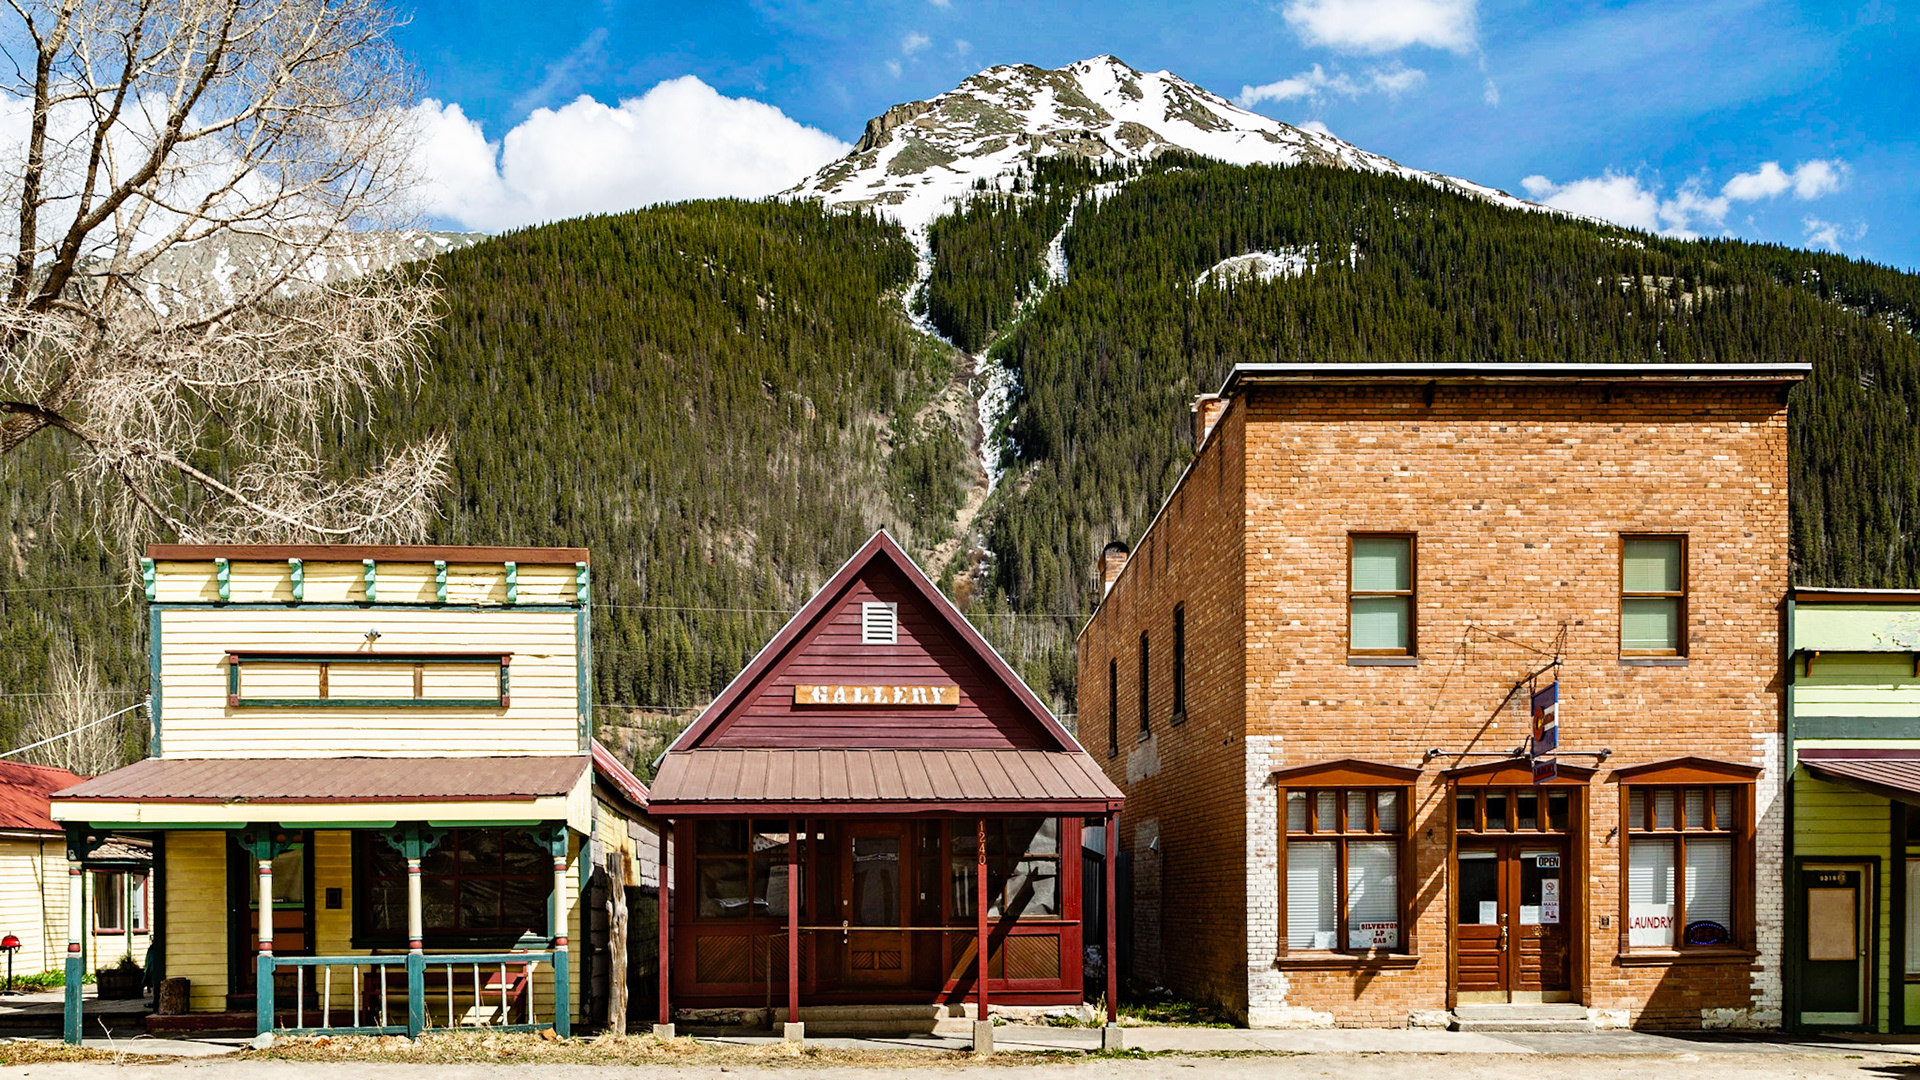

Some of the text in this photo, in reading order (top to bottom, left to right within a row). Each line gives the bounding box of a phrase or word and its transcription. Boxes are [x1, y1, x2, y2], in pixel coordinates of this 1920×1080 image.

[811, 686, 945, 704] GALLERY
[1538, 857, 1559, 867] OPEN
[1629, 917, 1674, 929] LAUNDRY
[1688, 928, 1723, 939] OPEN
